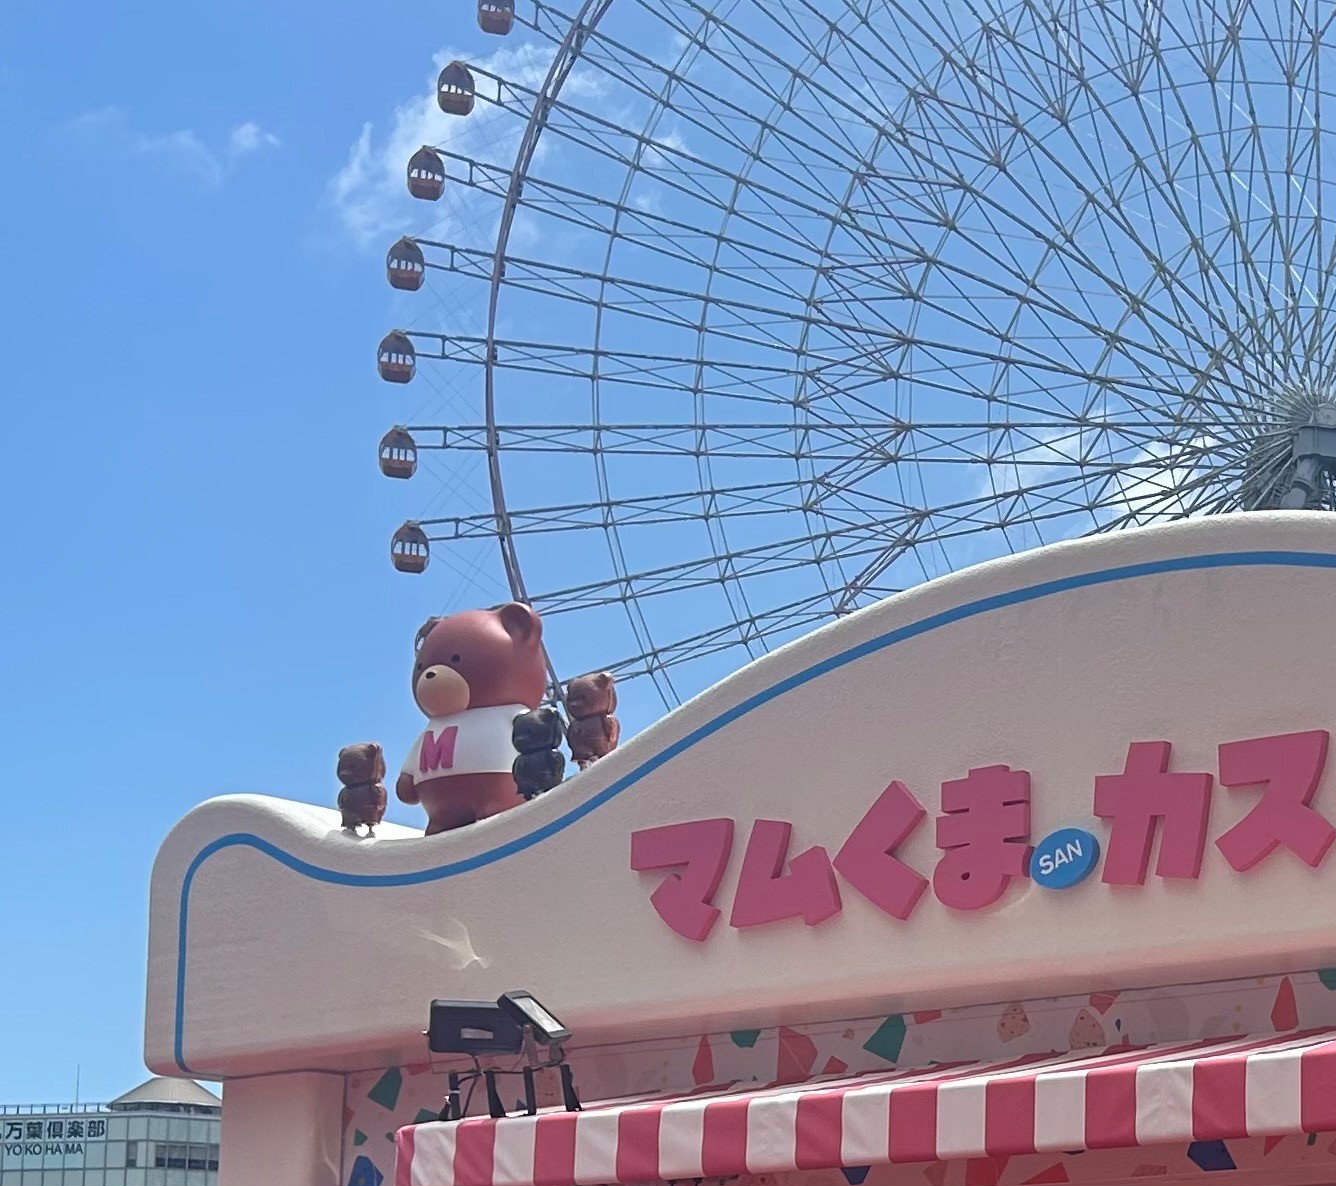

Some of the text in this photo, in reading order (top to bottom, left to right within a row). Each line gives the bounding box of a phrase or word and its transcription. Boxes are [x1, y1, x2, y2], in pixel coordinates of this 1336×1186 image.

[418, 726, 458, 774] M
[630, 764, 1032, 943] マムくま
[1039, 839, 1083, 875] SAN
